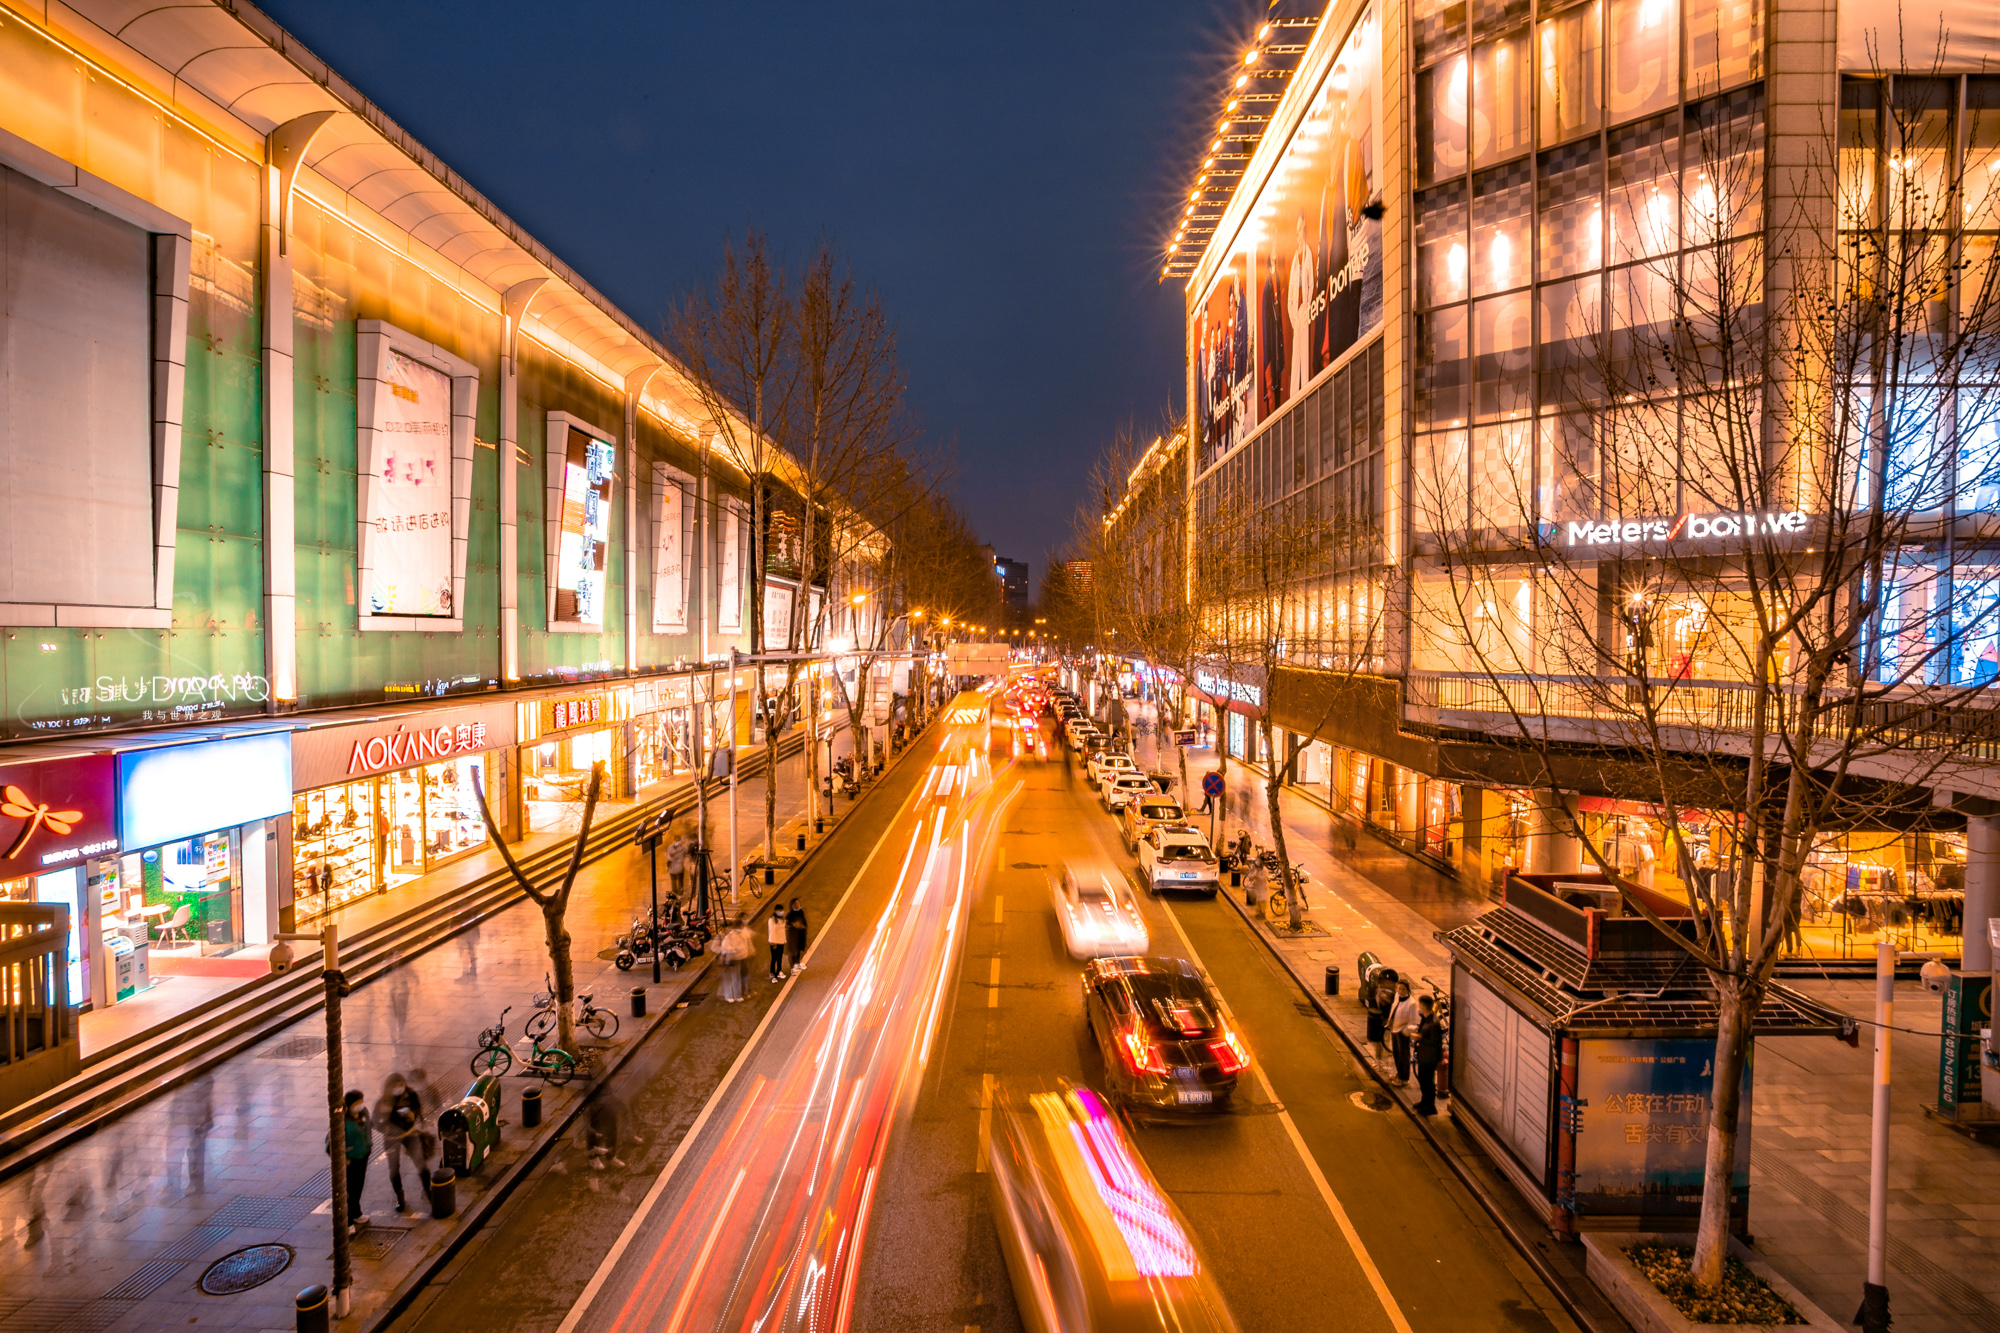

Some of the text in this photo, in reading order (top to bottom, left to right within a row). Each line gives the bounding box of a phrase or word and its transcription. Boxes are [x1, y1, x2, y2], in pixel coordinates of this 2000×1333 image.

[1568, 511, 1808, 546] Meters/bonwe
[455, 722, 486, 753] 奥康
[1427, 837, 1442, 852] SALE
[1605, 1092, 1705, 1114] 公筷在行动
[1624, 1123, 1710, 1145] 舌尖有文
